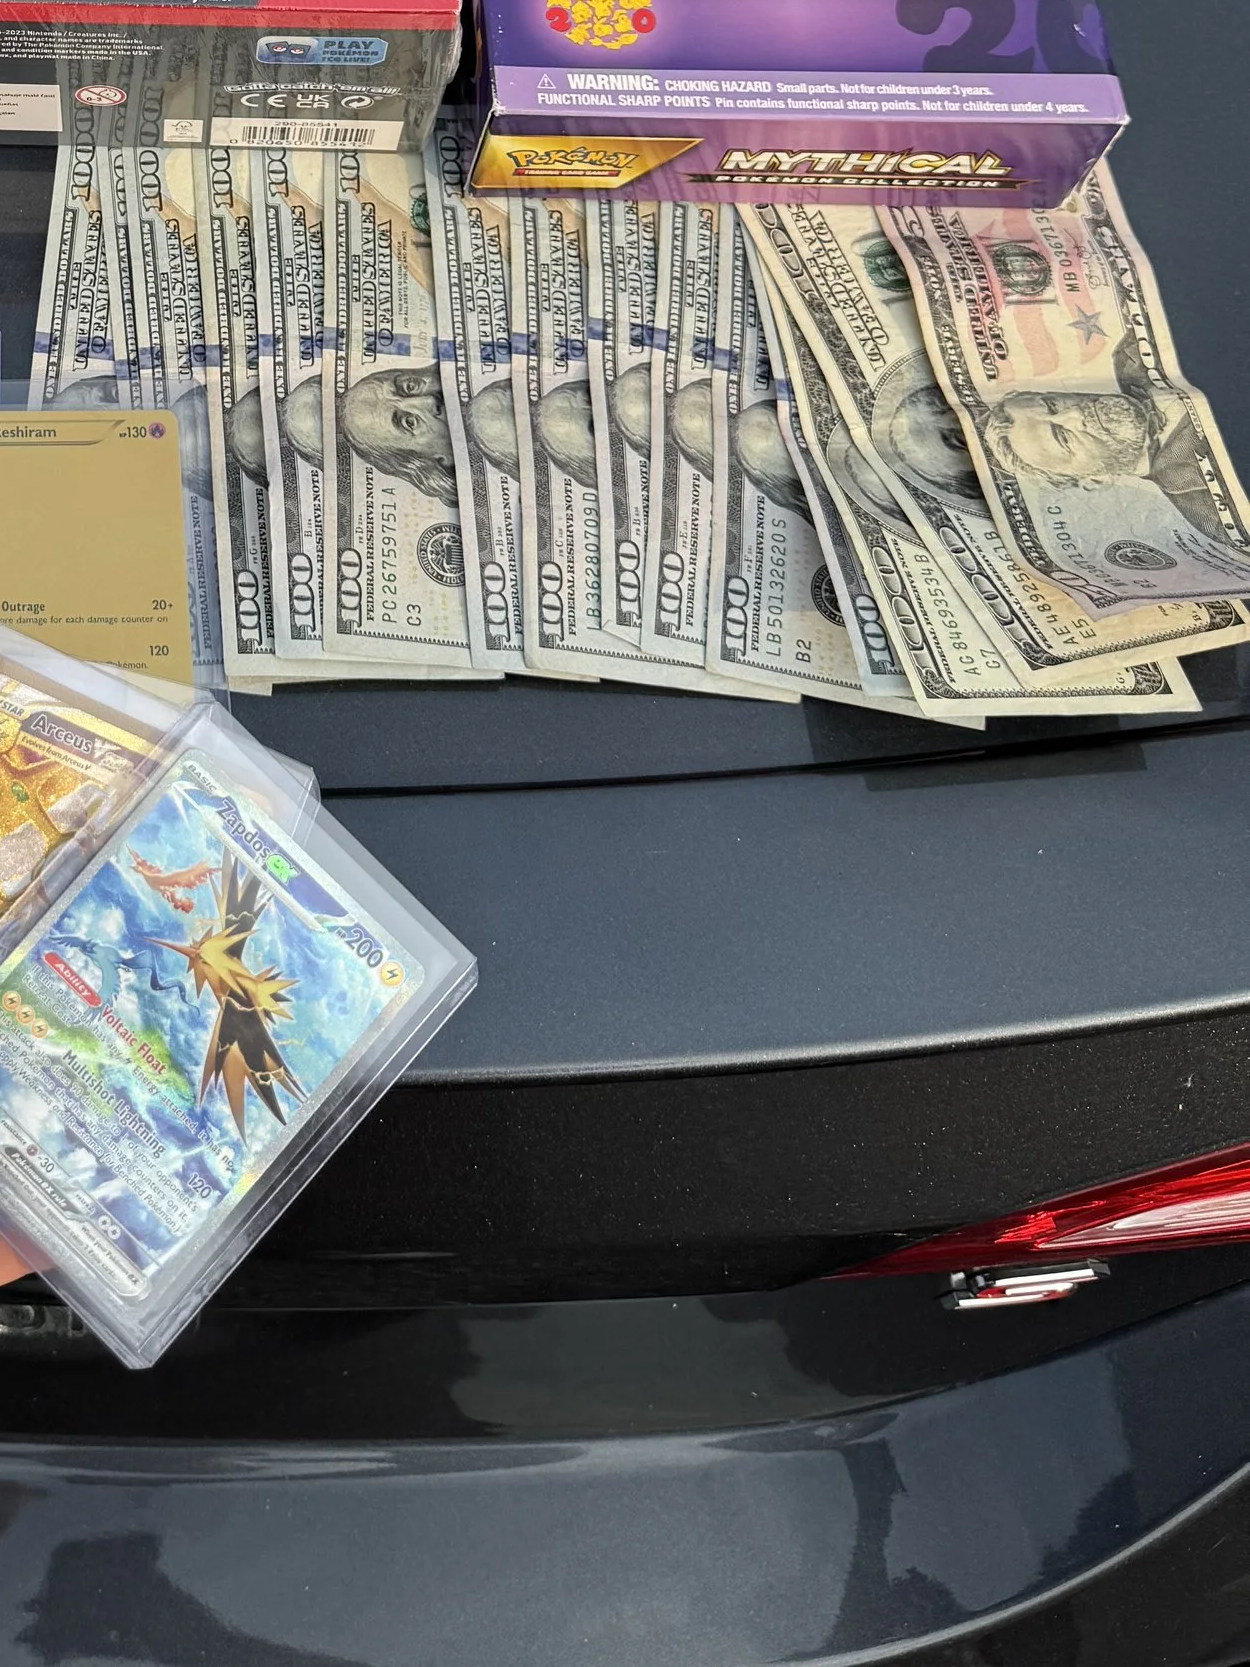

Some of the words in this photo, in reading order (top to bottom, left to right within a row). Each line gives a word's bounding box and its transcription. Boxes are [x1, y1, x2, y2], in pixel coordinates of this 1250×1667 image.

[324, 40, 374, 50] PLAY
[567, 74, 660, 91] WARNING:
[665, 79, 720, 93] CHOKING
[722, 80, 772, 93] HAZARD
[776, 82, 808, 94] Small
[808, 83, 839, 96] parts.
[841, 83, 860, 94] Not
[860, 84, 876, 95] for
[877, 84, 921, 96] children
[921, 85, 952, 96] under
[952, 85, 960, 96] 3
[960, 86, 994, 98] years.
[537, 92, 616, 107] FUNCTIONAL
[618, 94, 661, 108] SHARP
[664, 95, 711, 108] POINTS
[715, 96, 734, 109] Pin
[736, 97, 786, 110] contains
[787, 98, 844, 111] functional
[846, 99, 879, 113] sharp
[881, 100, 921, 114] points.
[922, 100, 942, 111] Not
[944, 100, 961, 112] for
[963, 101, 1009, 113] children
[1011, 102, 1043, 113] under
[1045, 102, 1054, 113] 4
[1055, 103, 1089, 115] years.
[507, 146, 641, 170] Pokémon
[716, 146, 1013, 176] MYTHICAL
[843, 177, 1001, 189] COLLECTION
[127, 426, 148, 439] 130
[364, 466, 374, 499] NOTE
[381, 487, 396, 496] A
[756, 495, 765, 530] NOTE
[771, 518, 787, 529] S
[365, 500, 374, 560] RESERVE
[381, 501, 397, 596] 26759751
[754, 530, 764, 591] RESERVE
[365, 560, 375, 622] FEDERAL
[766, 532, 787, 629] 50132620
[1, 600, 46, 615] Outrage
[152, 599, 174, 611] 20+
[381, 599, 397, 623] PC
[406, 603, 421, 627] C3
[751, 591, 762, 652] FEDERAL
[1072, 618, 1097, 639] E5
[150, 644, 170, 657] 120
[765, 633, 782, 656] LB
[795, 639, 812, 663] B2
[30, 712, 96, 755] Arceus
[214, 800, 276, 861] Zapdos
[342, 926, 389, 971] 200
[51, 959, 94, 1001] Ability
[98, 1006, 142, 1049] Voltaic
[134, 1041, 171, 1078] Float
[59, 1049, 119, 1107] Multishot
[109, 1099, 171, 1160] Lightning
[185, 1172, 214, 1201] 120
